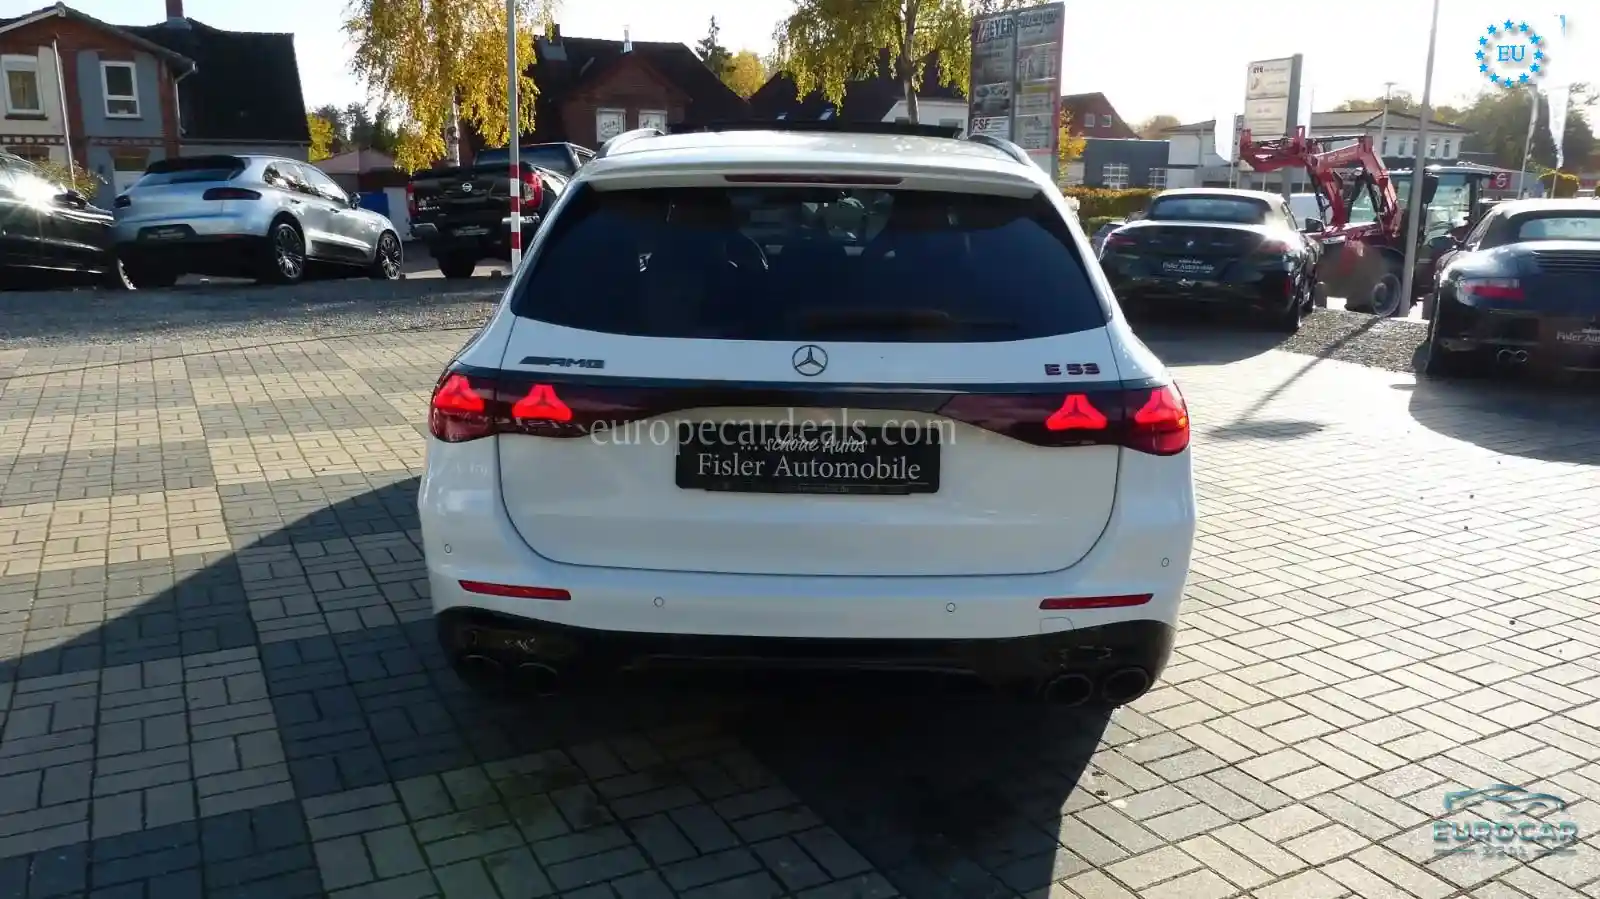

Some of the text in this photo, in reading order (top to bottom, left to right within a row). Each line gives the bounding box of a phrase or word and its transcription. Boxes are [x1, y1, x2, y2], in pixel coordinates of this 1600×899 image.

[1044, 363, 1100, 376] E 53
[697, 452, 921, 481] Fisler Automobile
